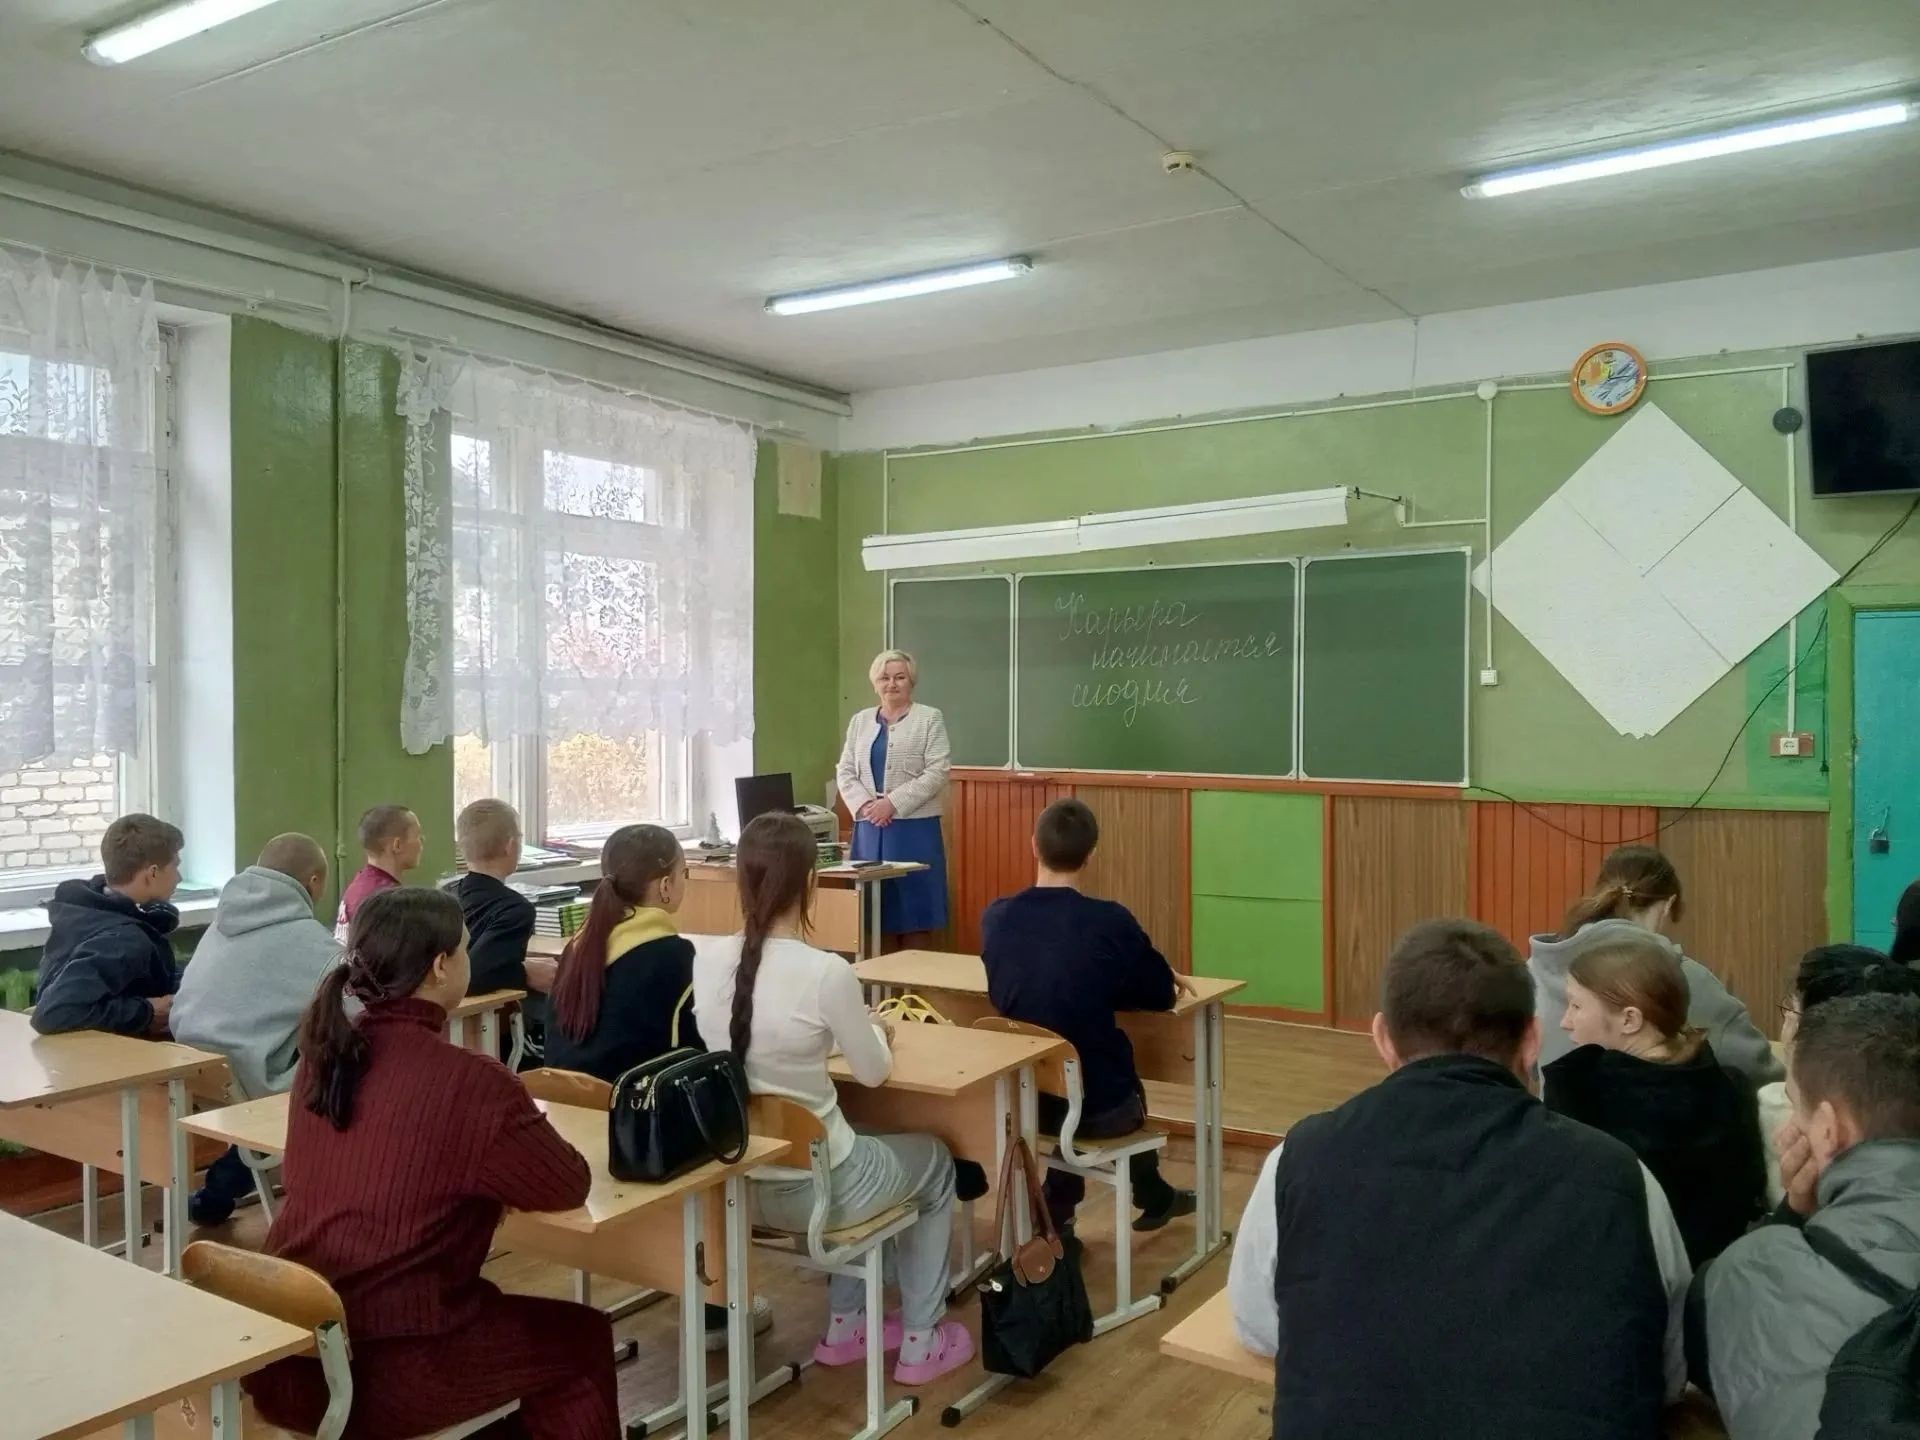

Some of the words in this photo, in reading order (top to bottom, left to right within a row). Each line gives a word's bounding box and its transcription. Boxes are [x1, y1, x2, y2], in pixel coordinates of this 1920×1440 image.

[1054, 591, 1200, 645] Карьера
[1092, 632, 1281, 671] начинается
[1072, 678, 1201, 728] сегодня
